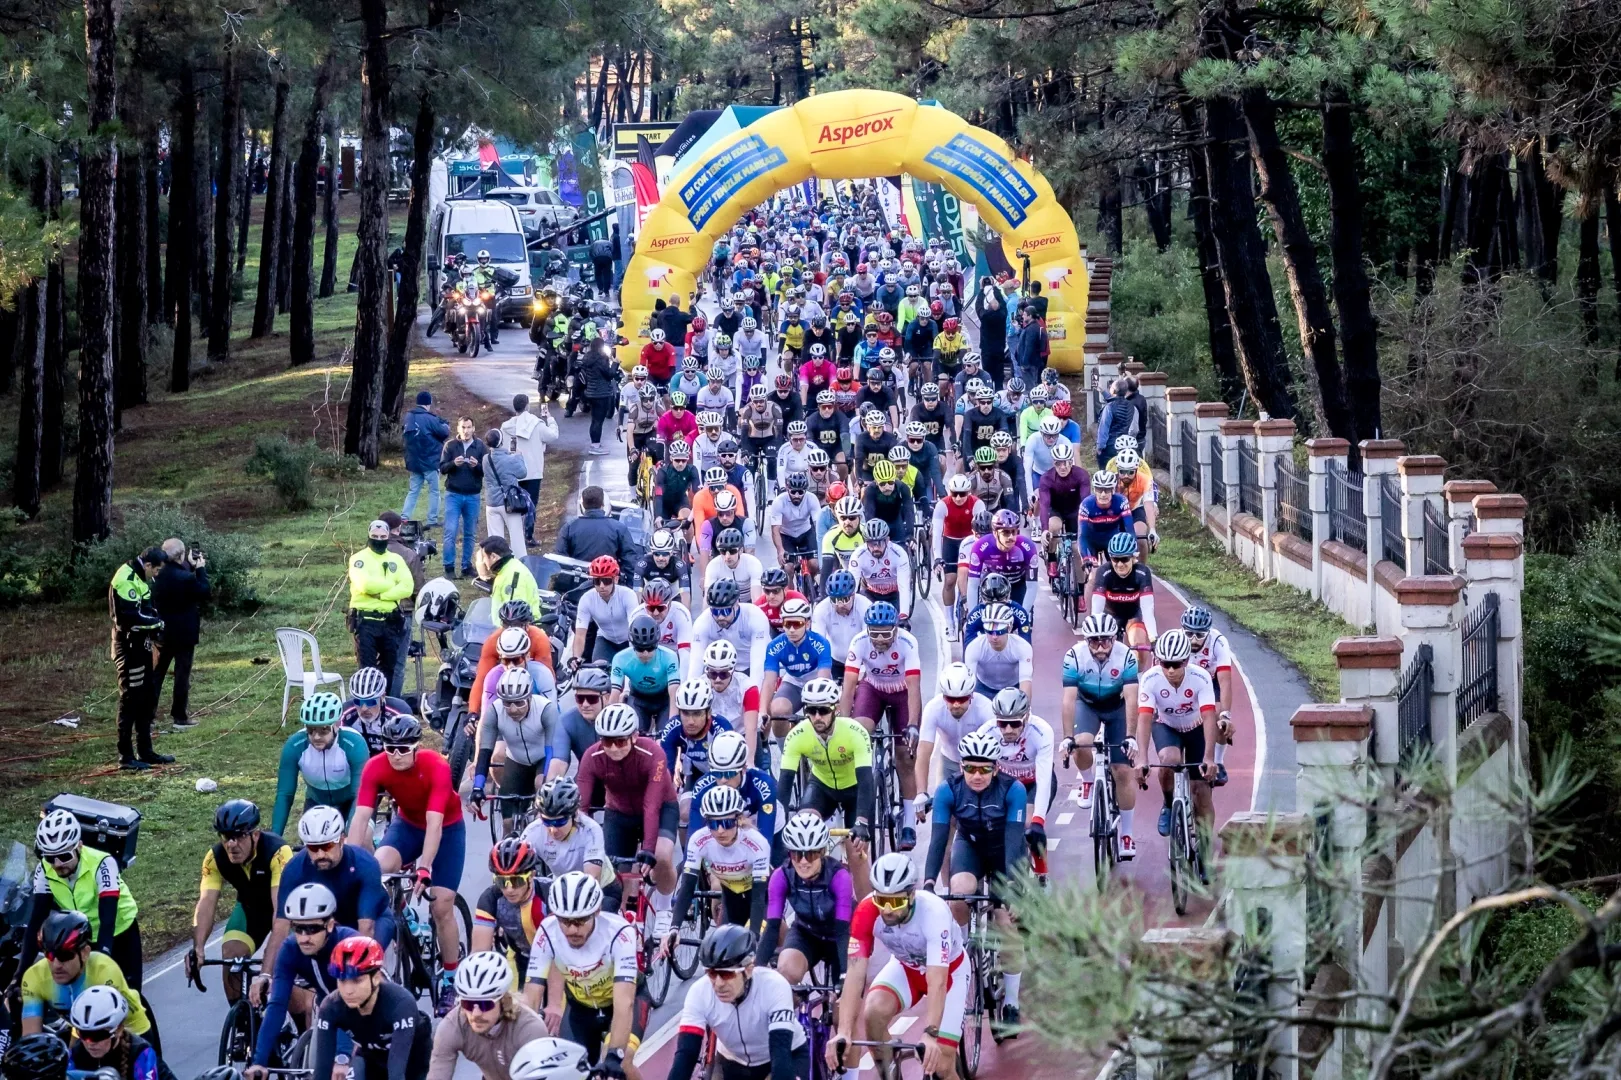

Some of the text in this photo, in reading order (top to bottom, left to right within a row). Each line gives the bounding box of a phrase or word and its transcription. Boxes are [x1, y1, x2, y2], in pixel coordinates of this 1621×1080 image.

[818, 116, 895, 144] Asperox
[675, 134, 697, 157] aximiles
[683, 186, 696, 202] EN
[693, 171, 709, 192] ÇOK
[707, 152, 733, 179] TERCİH
[730, 140, 760, 160] EDİLEN
[952, 138, 1032, 201] EN ÇOK TERCİH EDİLEN
[692, 197, 714, 225] SPREY
[711, 170, 743, 203] TEMİZLİK
[741, 152, 780, 177] MARKASI
[930, 151, 1022, 222] SPREY TEMİZLİK MARKASI
[650, 236, 690, 248] Asperox
[1022, 235, 1061, 249] Asperox
[871, 667, 900, 675] BCA
[660, 718, 682, 742] KARYA
[691, 774, 717, 800] KARYA
[752, 776, 771, 801] KARYA
[710, 862, 746, 874] Asperox
[393, 1017, 415, 1032] PAS
[540, 1052, 570, 1065] MET
